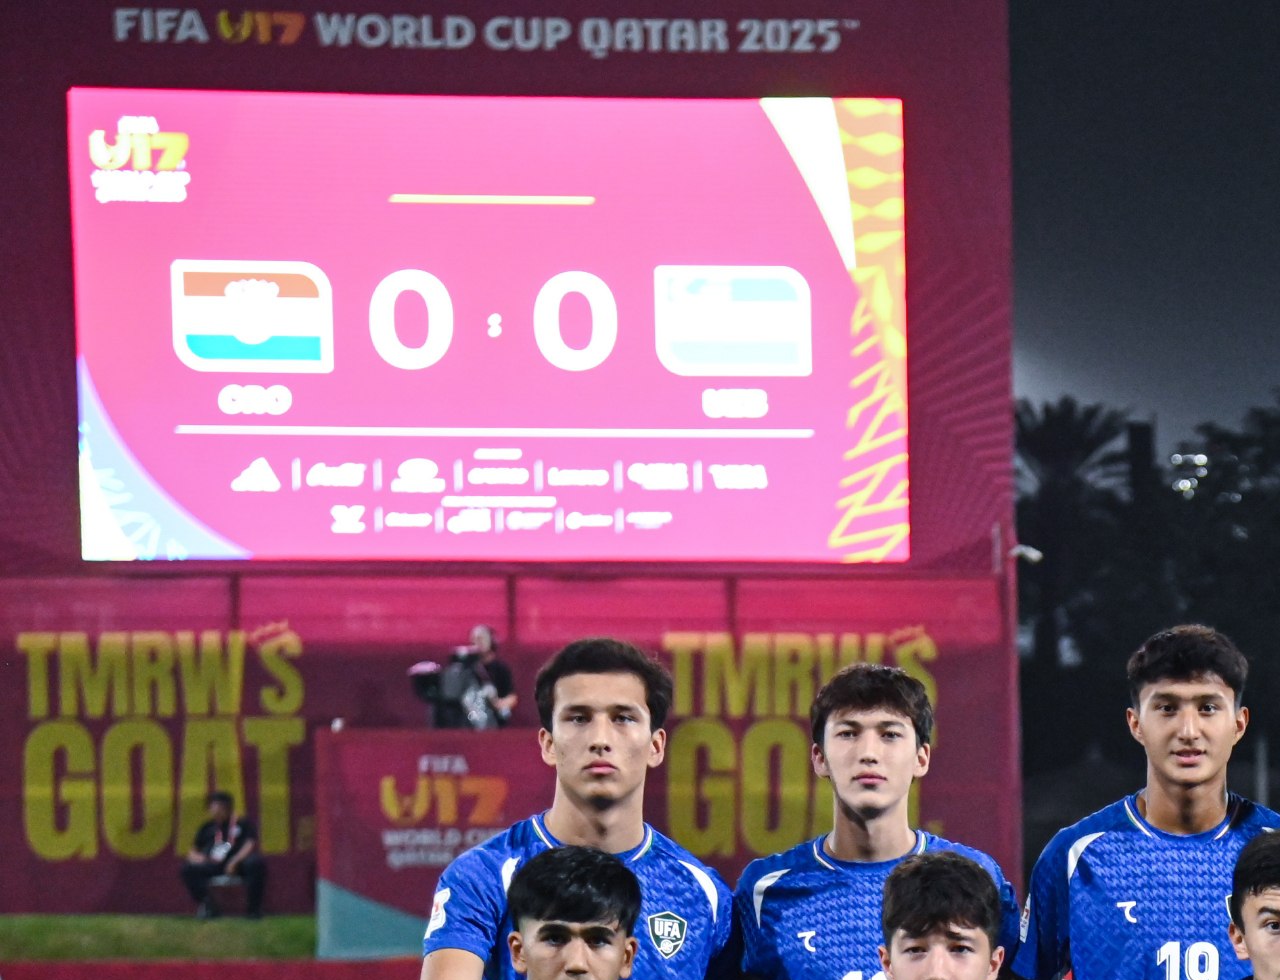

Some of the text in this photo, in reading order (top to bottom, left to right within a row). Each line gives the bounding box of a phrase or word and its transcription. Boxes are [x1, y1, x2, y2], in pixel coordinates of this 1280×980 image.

[114, 8, 209, 42] FIFA
[217, 10, 305, 43] U17
[315, 13, 476, 48] WORLD
[484, 16, 572, 50] CUP
[579, 18, 730, 58] QATAR
[369, 269, 454, 370] 0
[533, 271, 618, 371] 0
[24, 717, 306, 861] GOAT
[380, 775, 508, 826] U17
[654, 919, 681, 938] UFA
